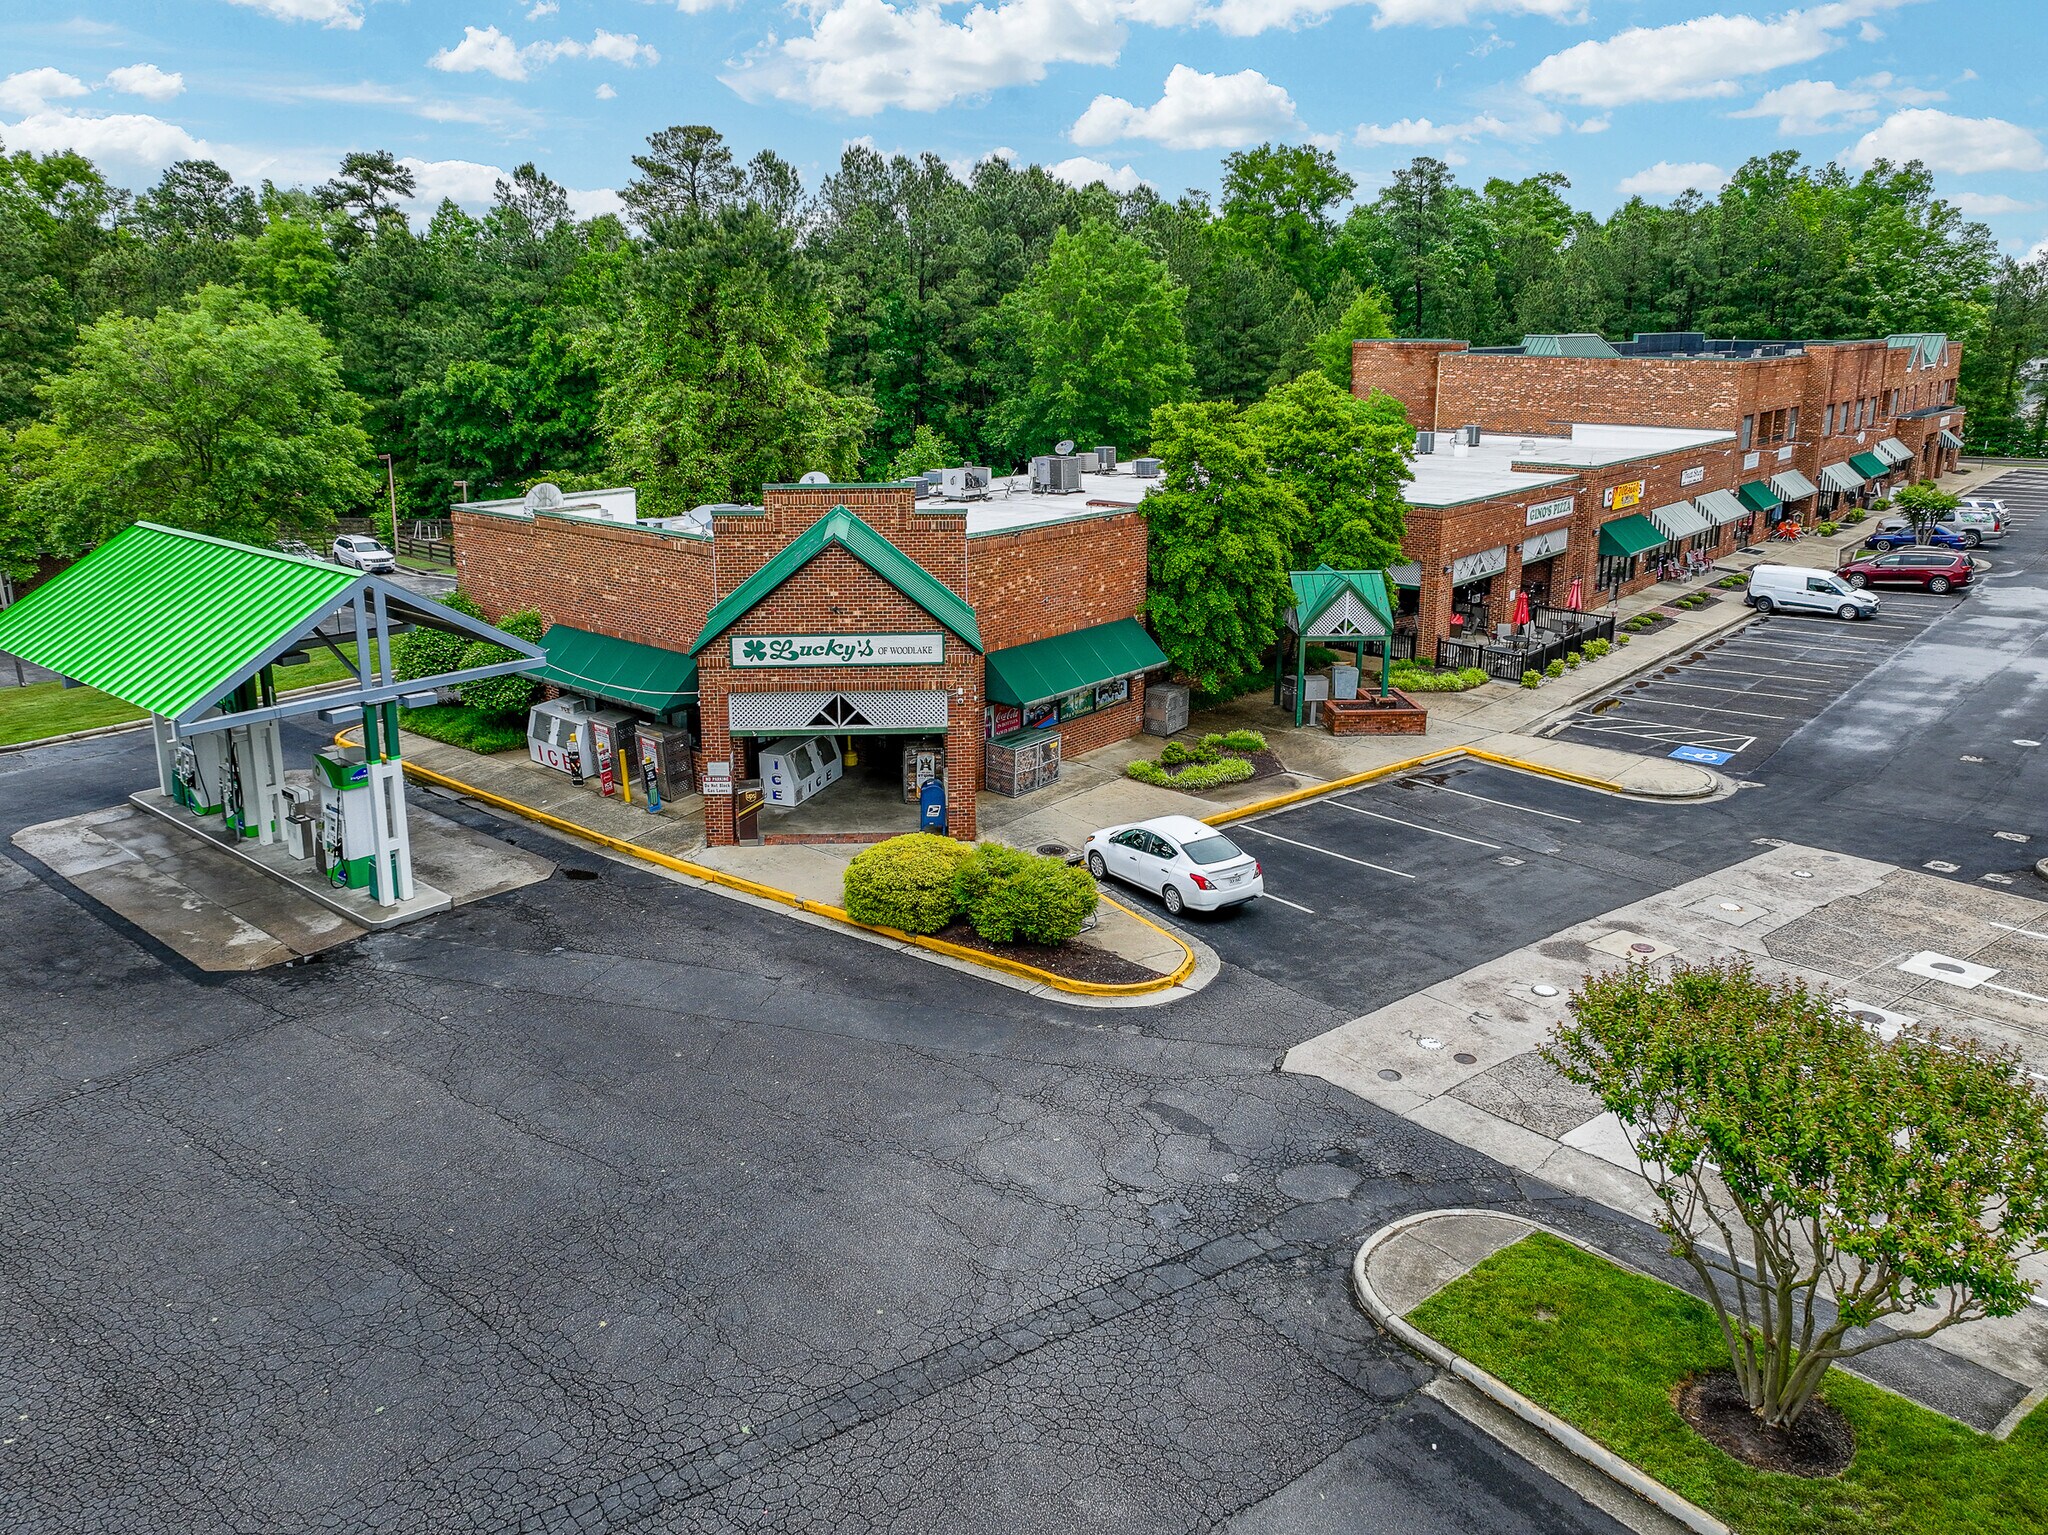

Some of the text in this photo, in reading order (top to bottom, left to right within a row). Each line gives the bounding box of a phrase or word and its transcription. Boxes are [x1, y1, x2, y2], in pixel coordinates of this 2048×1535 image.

[1530, 500, 1571, 520] GINO'S PIZZA
[769, 638, 933, 662] Lucky's OF WOODLAKE
[538, 744, 572, 772] ICE
[771, 760, 783, 801] ICE
[808, 769, 832, 793] ICE
